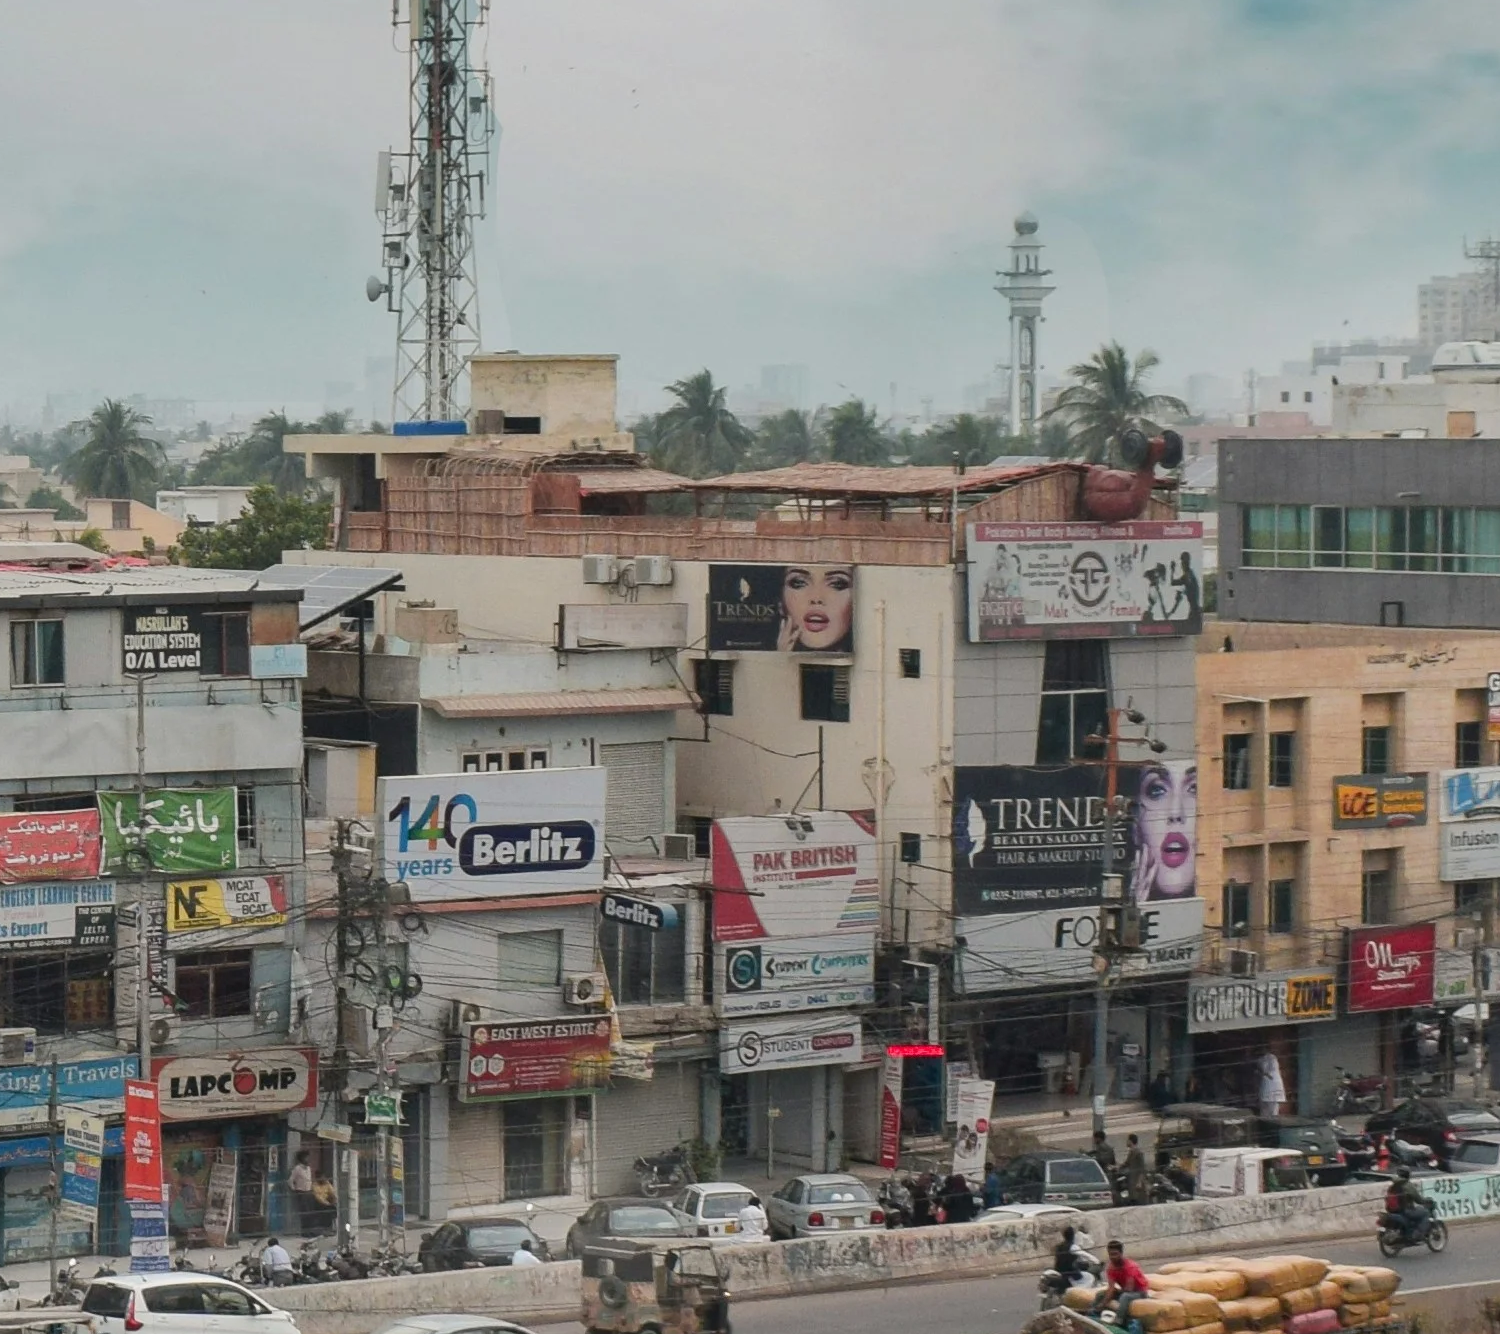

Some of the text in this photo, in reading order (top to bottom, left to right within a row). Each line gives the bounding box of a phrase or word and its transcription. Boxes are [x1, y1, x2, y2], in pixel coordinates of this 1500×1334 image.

[124, 633, 200, 650] EDUCATION SYSTEM
[125, 651, 200, 669] O/A Level
[472, 827, 584, 867] Berlitz
[994, 834, 1042, 845] BEAUTY
[1046, 834, 1087, 844] SALON
[1450, 829, 1499, 847] Infusion
[753, 845, 857, 870] PAK BRITISH
[997, 852, 1026, 864] HAIR
[1038, 849, 1082, 863] MAKEUP
[1084, 847, 1126, 861] STUIO
[396, 856, 453, 882] years
[753, 872, 795, 883] INSTITUTE
[227, 880, 255, 892] MCAT
[0, 888, 36, 908] ENGLISH
[38, 885, 79, 905] LEARNING
[236, 892, 260, 903] ECAT
[242, 904, 268, 915] BCAT
[604, 896, 660, 927] Berlitz
[1195, 976, 1334, 1023] COMPUTER ZONE
[491, 1022, 595, 1041] EAST WEST ESTATE
[764, 1039, 812, 1053] STUDENT
[64, 1061, 136, 1085] Travels
